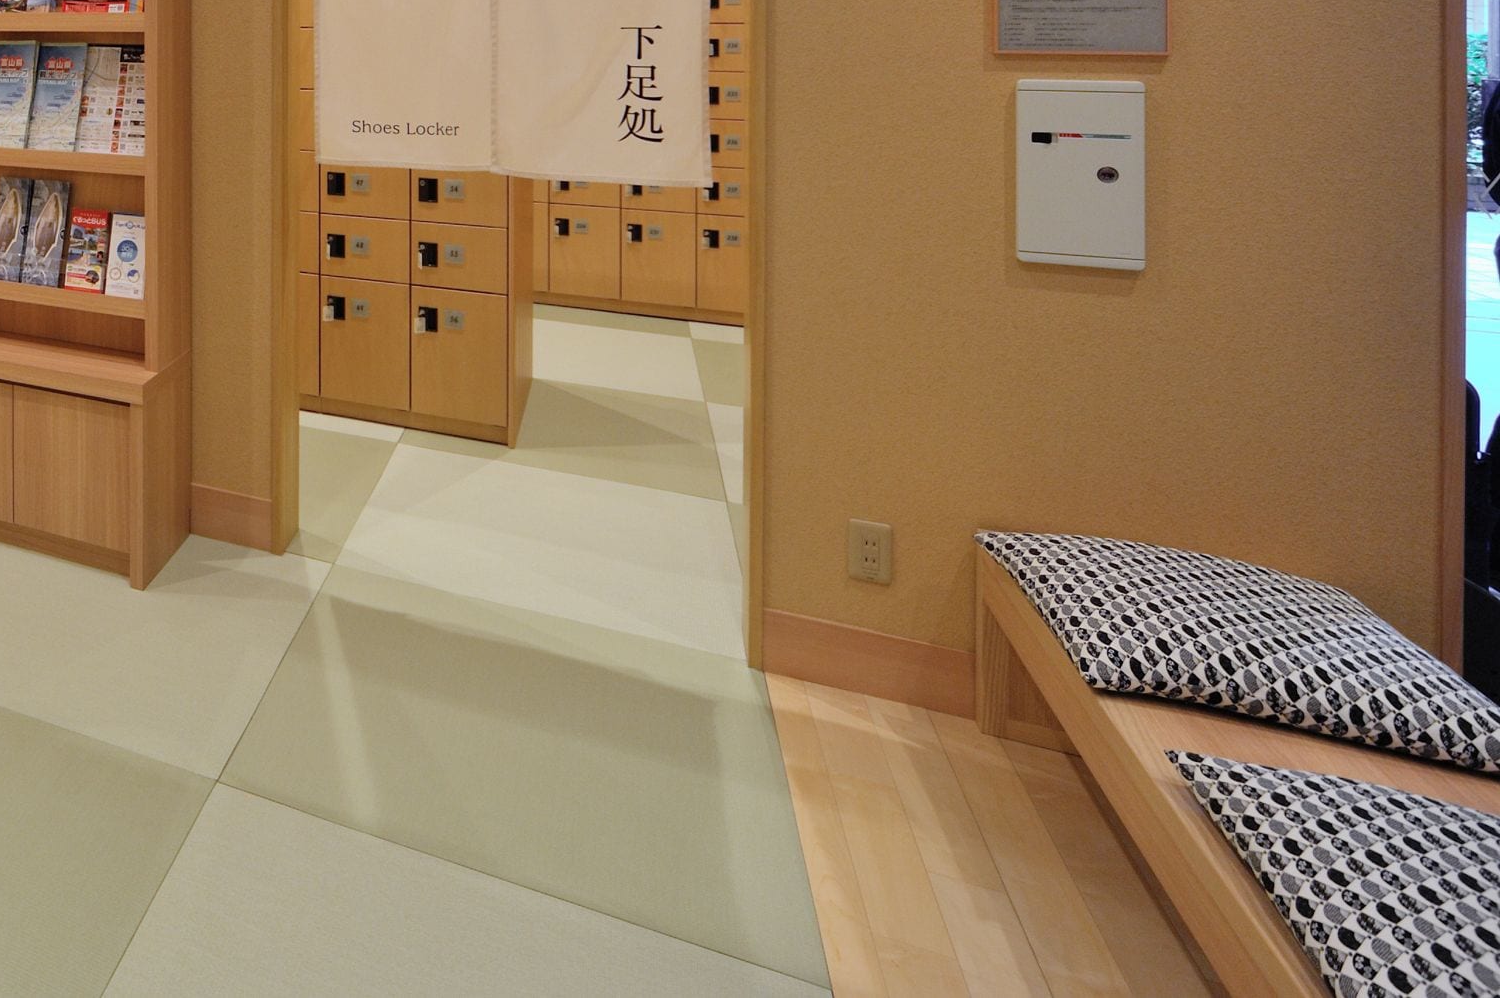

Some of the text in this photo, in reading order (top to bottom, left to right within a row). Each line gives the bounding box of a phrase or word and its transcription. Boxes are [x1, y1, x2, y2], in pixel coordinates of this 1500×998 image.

[617, 25, 665, 143] 下足処
[351, 120, 460, 136] Shoes Locker
